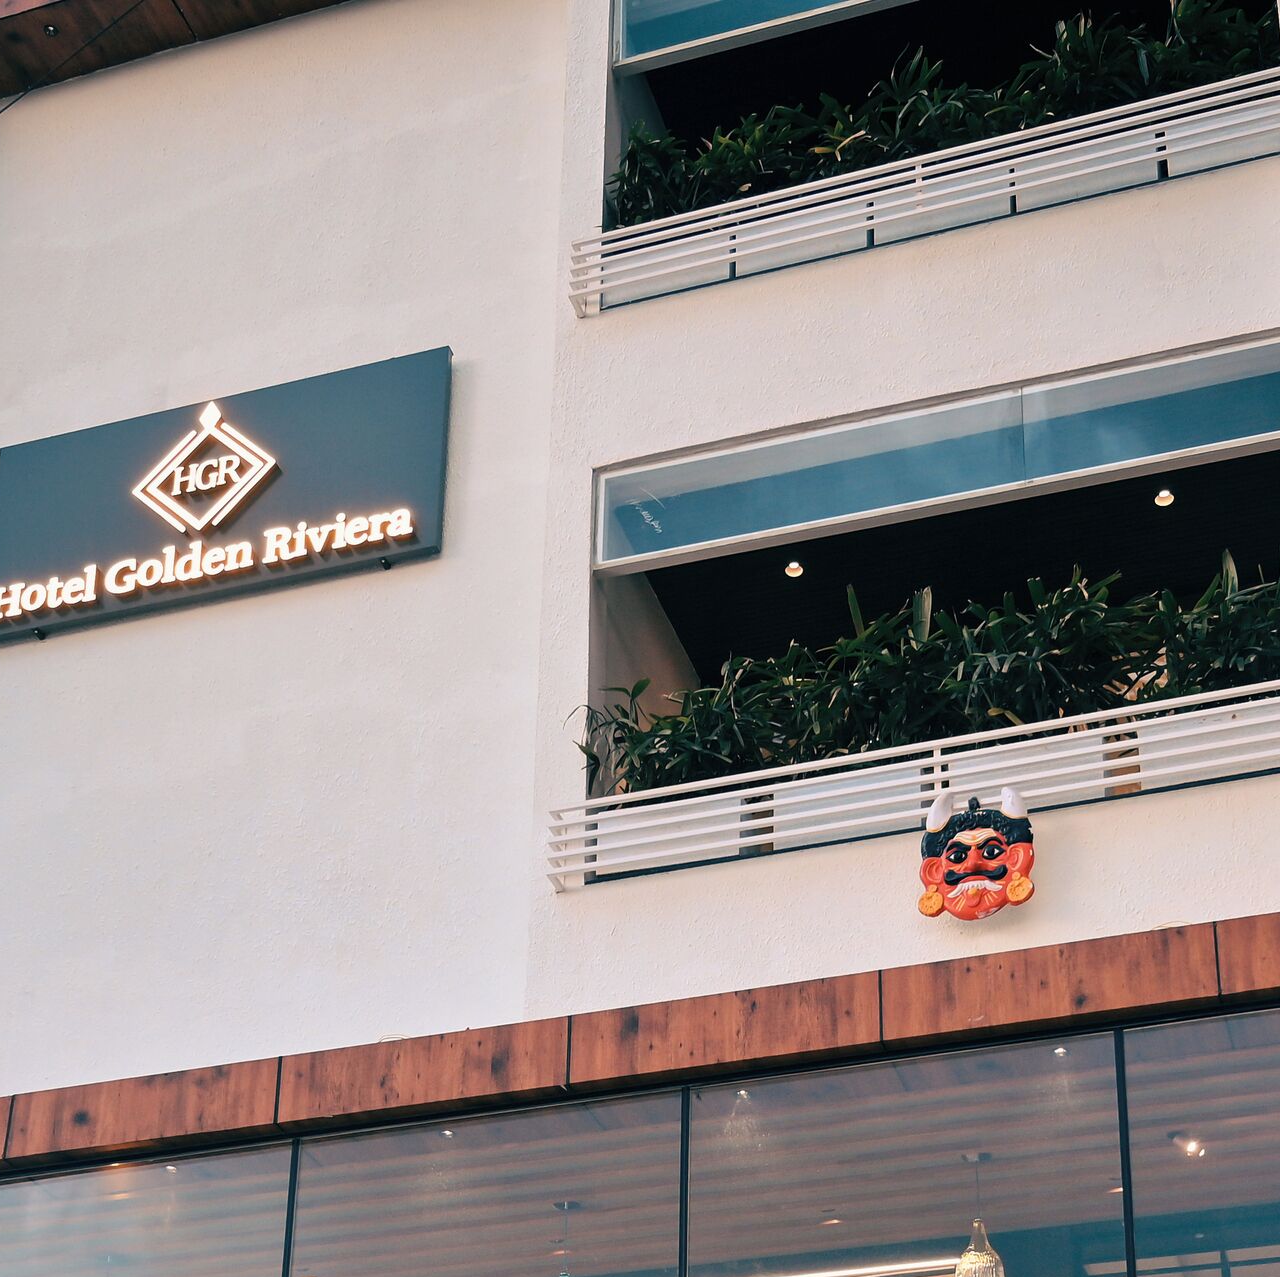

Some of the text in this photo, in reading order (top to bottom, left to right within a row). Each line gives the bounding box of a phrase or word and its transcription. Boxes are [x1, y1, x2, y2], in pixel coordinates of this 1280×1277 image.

[171, 454, 242, 497] HGR
[104, 540, 254, 595] Golden
[263, 508, 413, 564] Riviera
